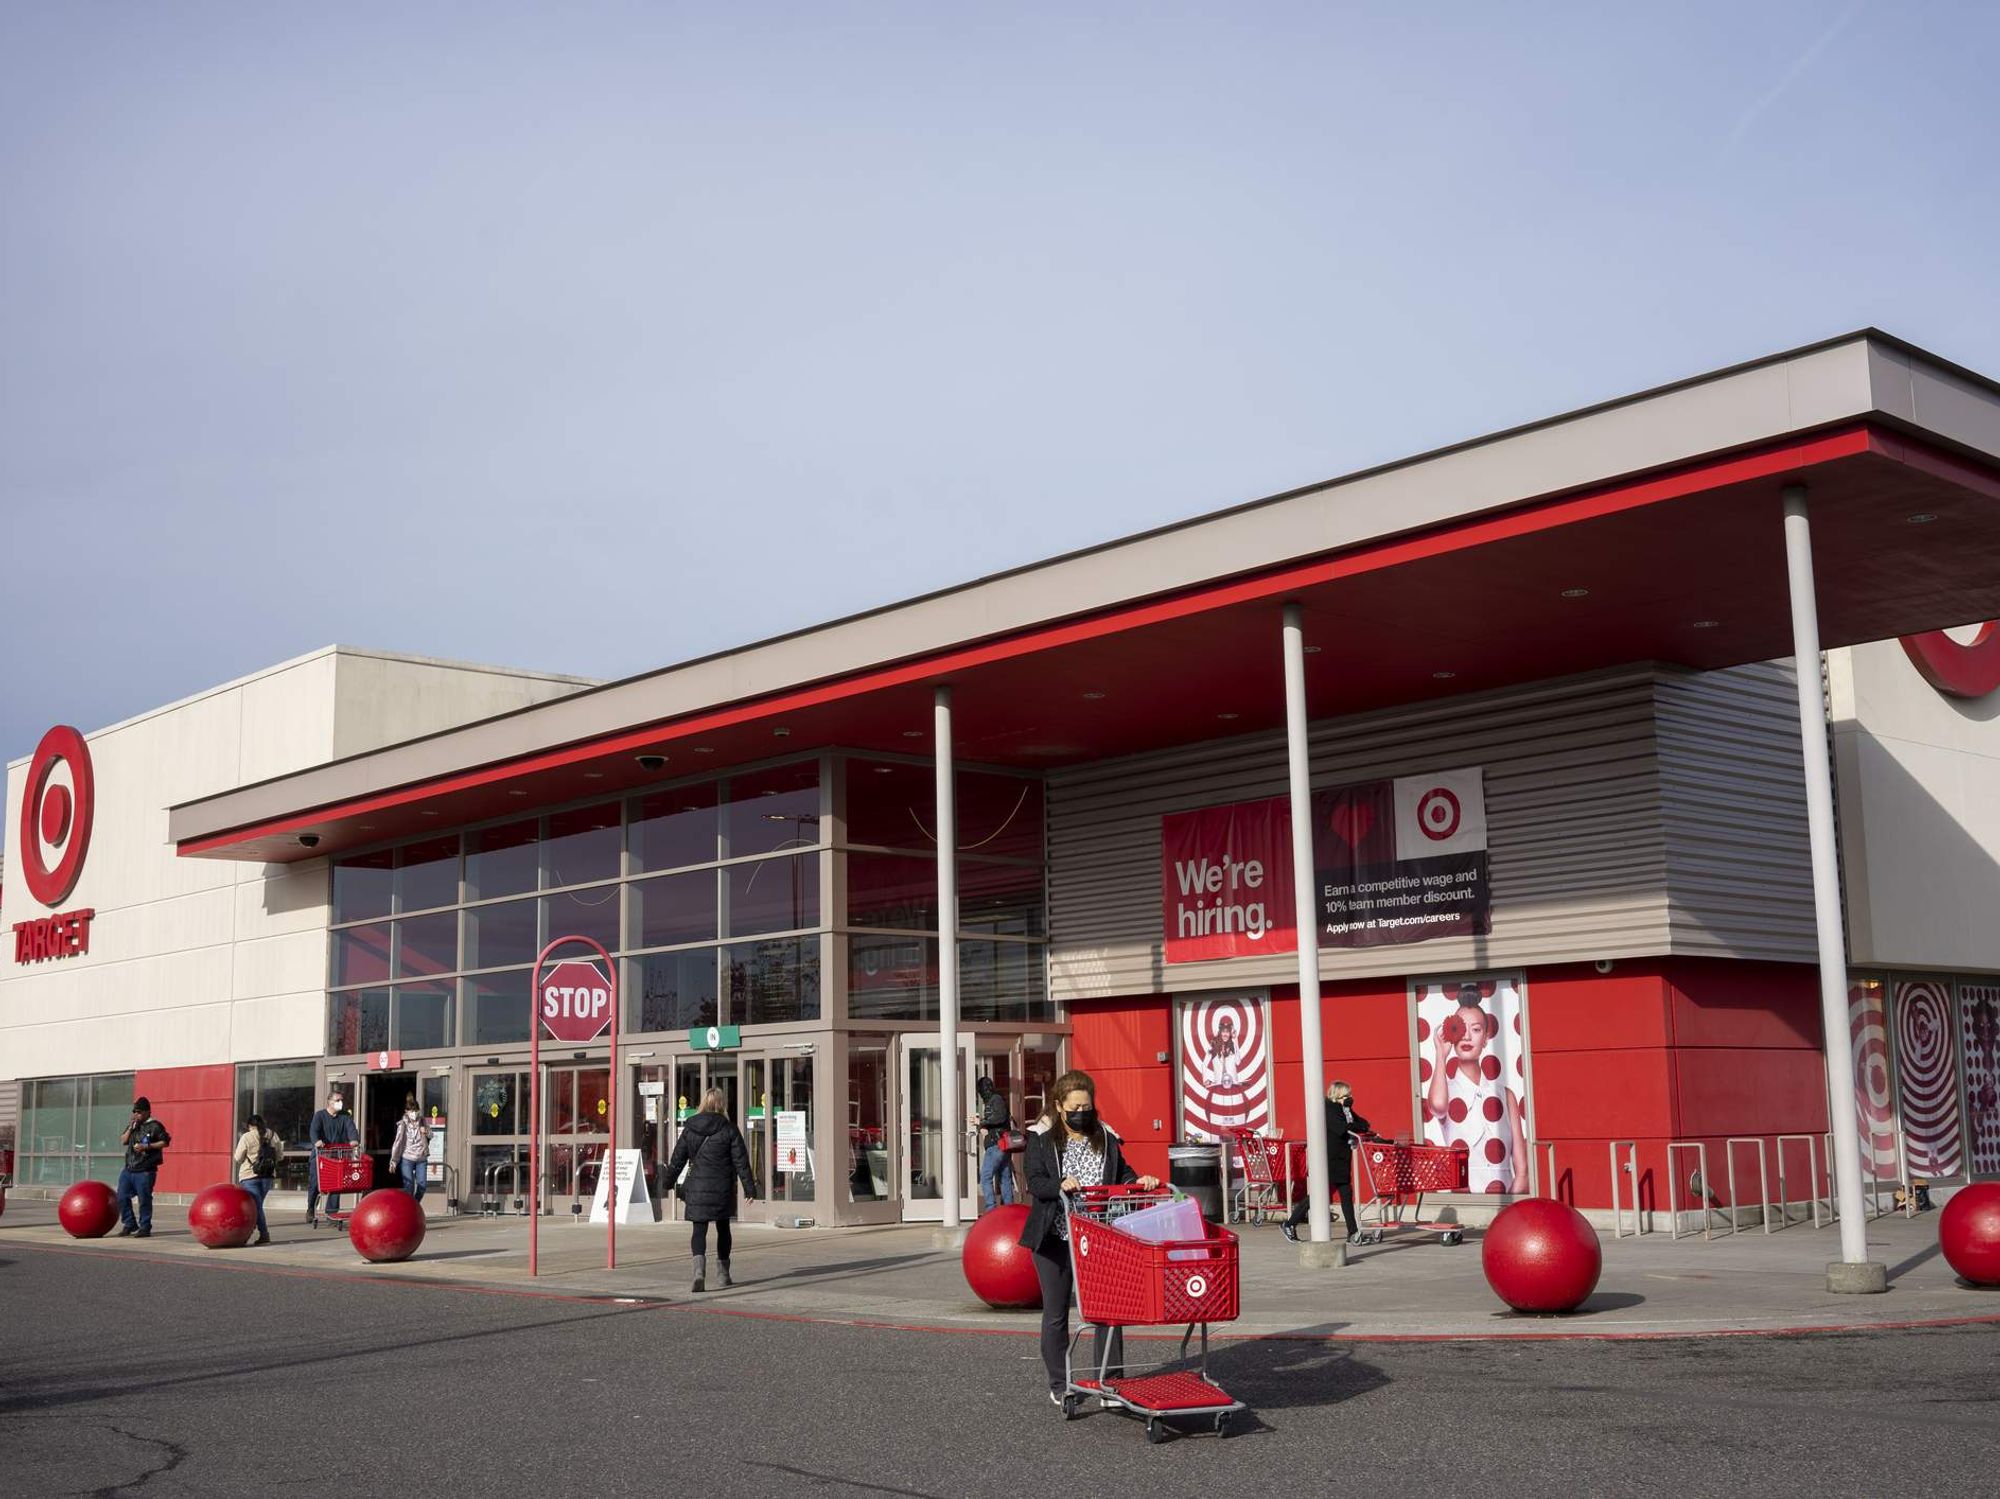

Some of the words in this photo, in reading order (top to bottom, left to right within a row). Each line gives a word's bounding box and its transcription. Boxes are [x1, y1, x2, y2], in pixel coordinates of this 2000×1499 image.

[1175, 854, 1264, 896] We're
[1324, 884, 1349, 897] Earn
[1350, 884, 1356, 894] a
[1357, 876, 1420, 893] competitive
[1422, 873, 1453, 887] wage
[1455, 868, 1477, 883] and
[1325, 900, 1347, 913] 10%
[1348, 899, 1374, 911] team
[1376, 894, 1421, 908] member
[1423, 887, 1475, 904] discount.
[1178, 897, 1273, 940] hiring.
[1326, 922, 1349, 934] Apply
[1349, 921, 1365, 930] now
[1366, 918, 1376, 928] at
[1377, 912, 1461, 929] Target.com/careers
[12, 908, 95, 966] TARGET
[544, 986, 607, 1018] STOP
